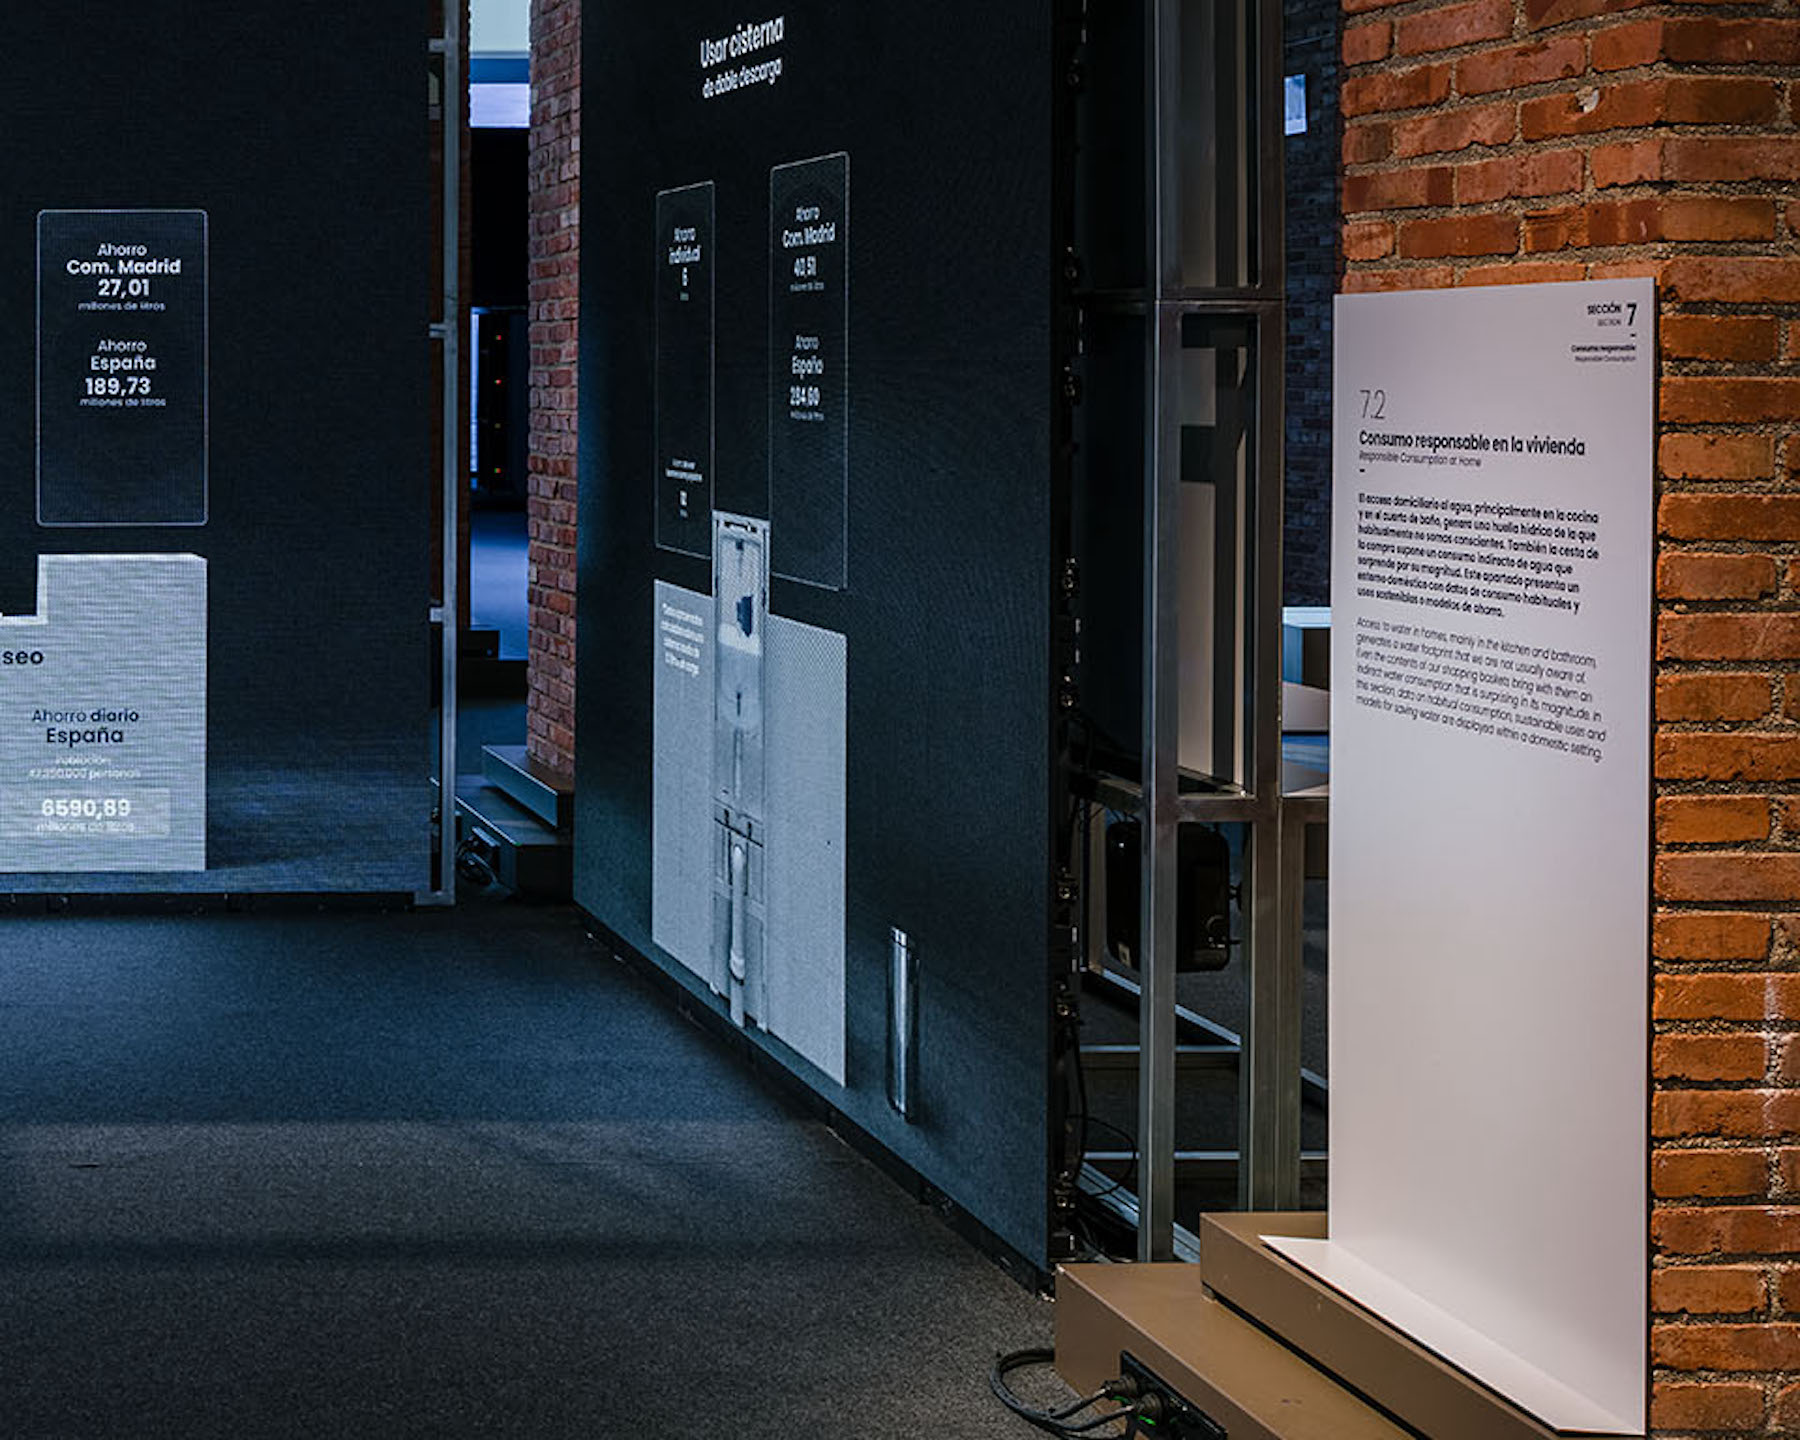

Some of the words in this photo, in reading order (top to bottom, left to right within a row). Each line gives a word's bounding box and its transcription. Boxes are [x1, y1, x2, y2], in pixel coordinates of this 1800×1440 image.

[700, 38, 729, 68] Usar
[729, 15, 785, 58] cisterna
[702, 76, 715, 99] de
[715, 68, 738, 95] doble
[738, 57, 783, 86] descarga
[803, 221, 836, 247] Madrid
[96, 242, 148, 256] Ahorro
[66, 259, 114, 274] Com.
[117, 257, 181, 274] Madrid
[97, 278, 149, 299] 27,01
[122, 301, 138, 310] de
[1587, 301, 1622, 315] SECCIÓN
[1626, 303, 1637, 326] 7
[96, 338, 148, 353] Ahorro
[90, 354, 156, 374] España
[791, 355, 824, 380] España
[85, 375, 151, 396] 189,73
[124, 397, 140, 406] de
[1359, 389, 1387, 419] 7.2
[1358, 429, 1414, 447] Consumo
[1414, 433, 1491, 454] responsable
[1492, 437, 1509, 452] en
[1510, 435, 1523, 452] la
[1525, 436, 1585, 456] vivienda
[1399, 451, 1448, 465] Consumption
[1458, 457, 1482, 467] Home
[1357, 492, 1366, 503] El
[1393, 495, 1440, 510] domiciliario
[1438, 499, 1449, 510] al
[1449, 501, 1473, 514] agua,
[1473, 501, 1542, 519] principalmente
[1555, 508, 1565, 521] la
[1565, 511, 1599, 524] cocina
[1357, 509, 1364, 521] y
[1382, 511, 1407, 523] cuarto
[1408, 512, 1418, 524] de
[1419, 513, 1442, 527] baño,
[1443, 517, 1472, 531] genera
[1473, 520, 1491, 531] una
[1492, 520, 1519, 534] huella
[1520, 522, 1553, 537] hídrica
[1553, 526, 1566, 538] de
[1567, 526, 1576, 540] la
[1576, 530, 1597, 543] que
[1357, 538, 1366, 550] la
[1364, 541, 1395, 555] compra
[1396, 545, 1426, 557] supone
[1425, 549, 1437, 558] un
[1436, 549, 1476, 563] consumo
[1477, 551, 1516, 568] indirecto
[1514, 557, 1529, 570] de
[1529, 560, 1553, 574] agua
[1553, 563, 1573, 576] que
[1425, 532, 1452, 544] somos
[1452, 535, 1506, 549] conscientes.
[1507, 538, 1547, 554] También
[1548, 542, 1558, 555] la
[1557, 545, 1585, 559] cesta
[1585, 546, 1600, 560] de
[1396, 560, 1410, 573] por
[1420, 563, 1463, 579] magnitud.
[1463, 567, 1482, 580] Este
[1482, 571, 1523, 586] apartado
[1523, 576, 1566, 591] presenta
[1567, 582, 1580, 593] un
[31, 708, 87, 723] Ahorro
[89, 707, 140, 722] diario
[45, 726, 124, 748] España
[41, 798, 132, 820] 6590,89
